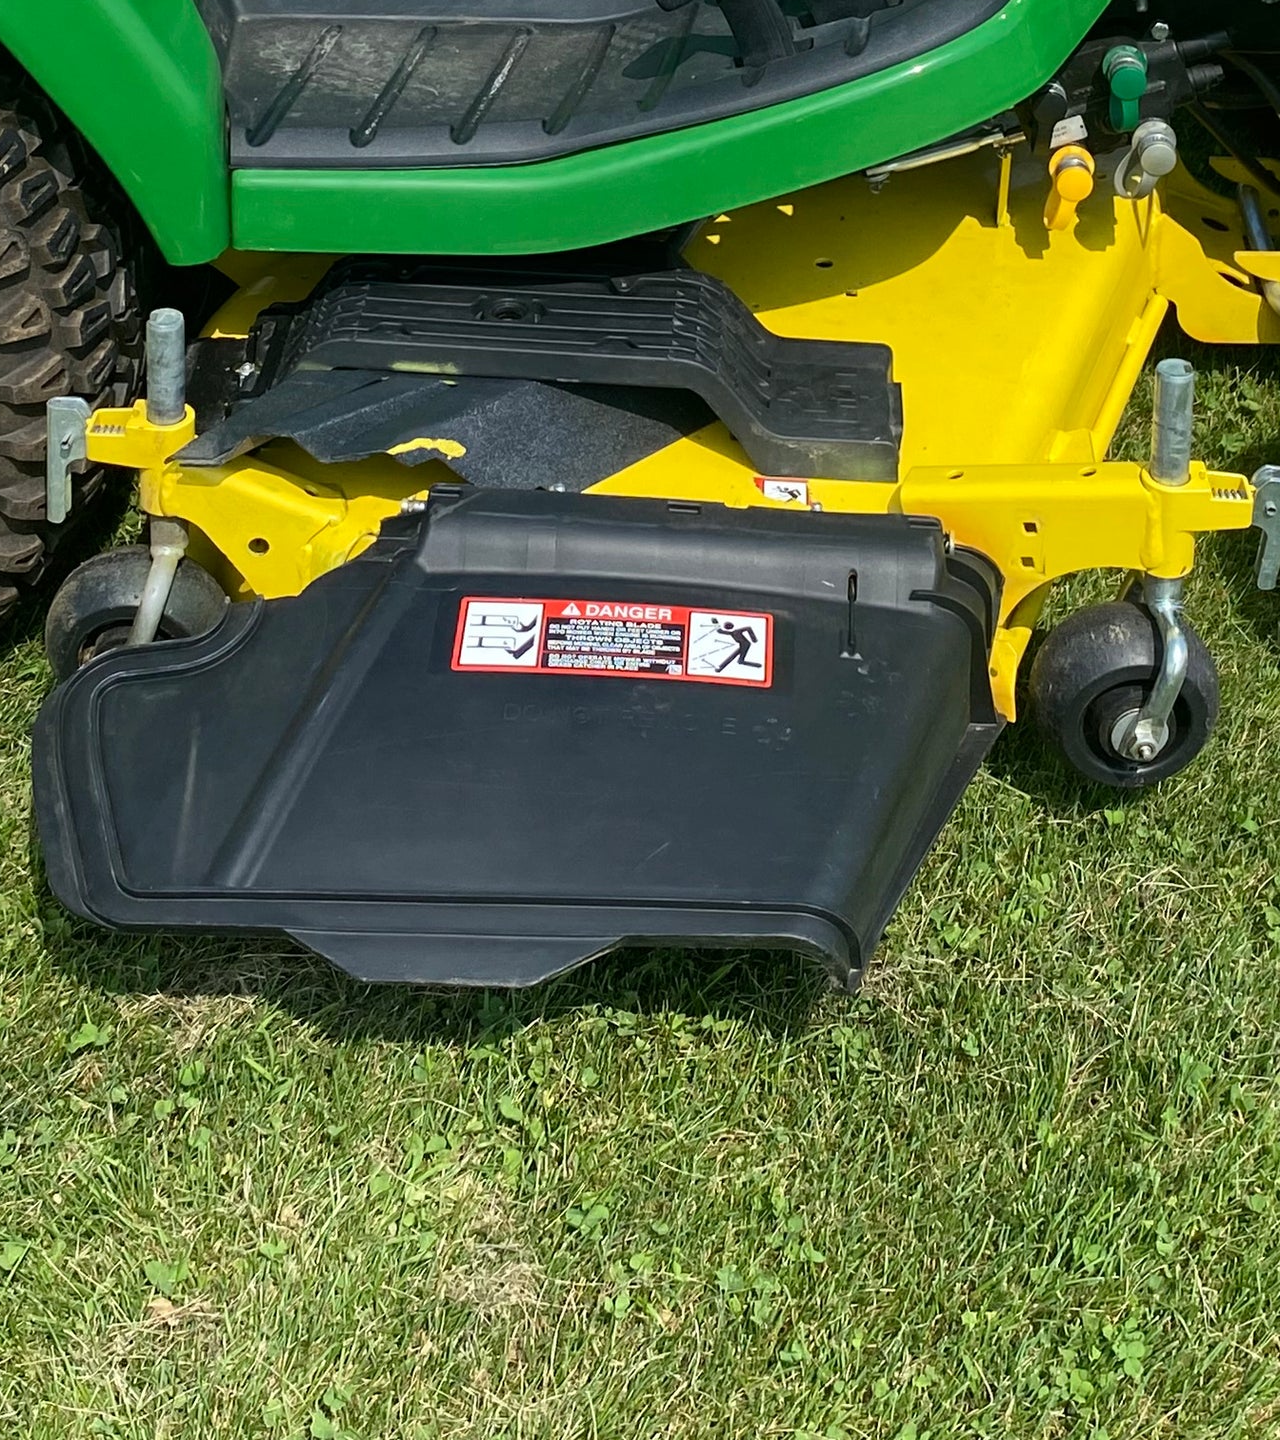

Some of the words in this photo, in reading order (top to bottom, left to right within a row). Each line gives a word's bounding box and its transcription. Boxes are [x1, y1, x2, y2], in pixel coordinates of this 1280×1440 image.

[585, 604, 673, 621] DANGER
[569, 618, 624, 628] ROTATING
[626, 621, 662, 630] BLADE
[566, 634, 612, 643] THROWN
[614, 636, 664, 646] OBJECTS
